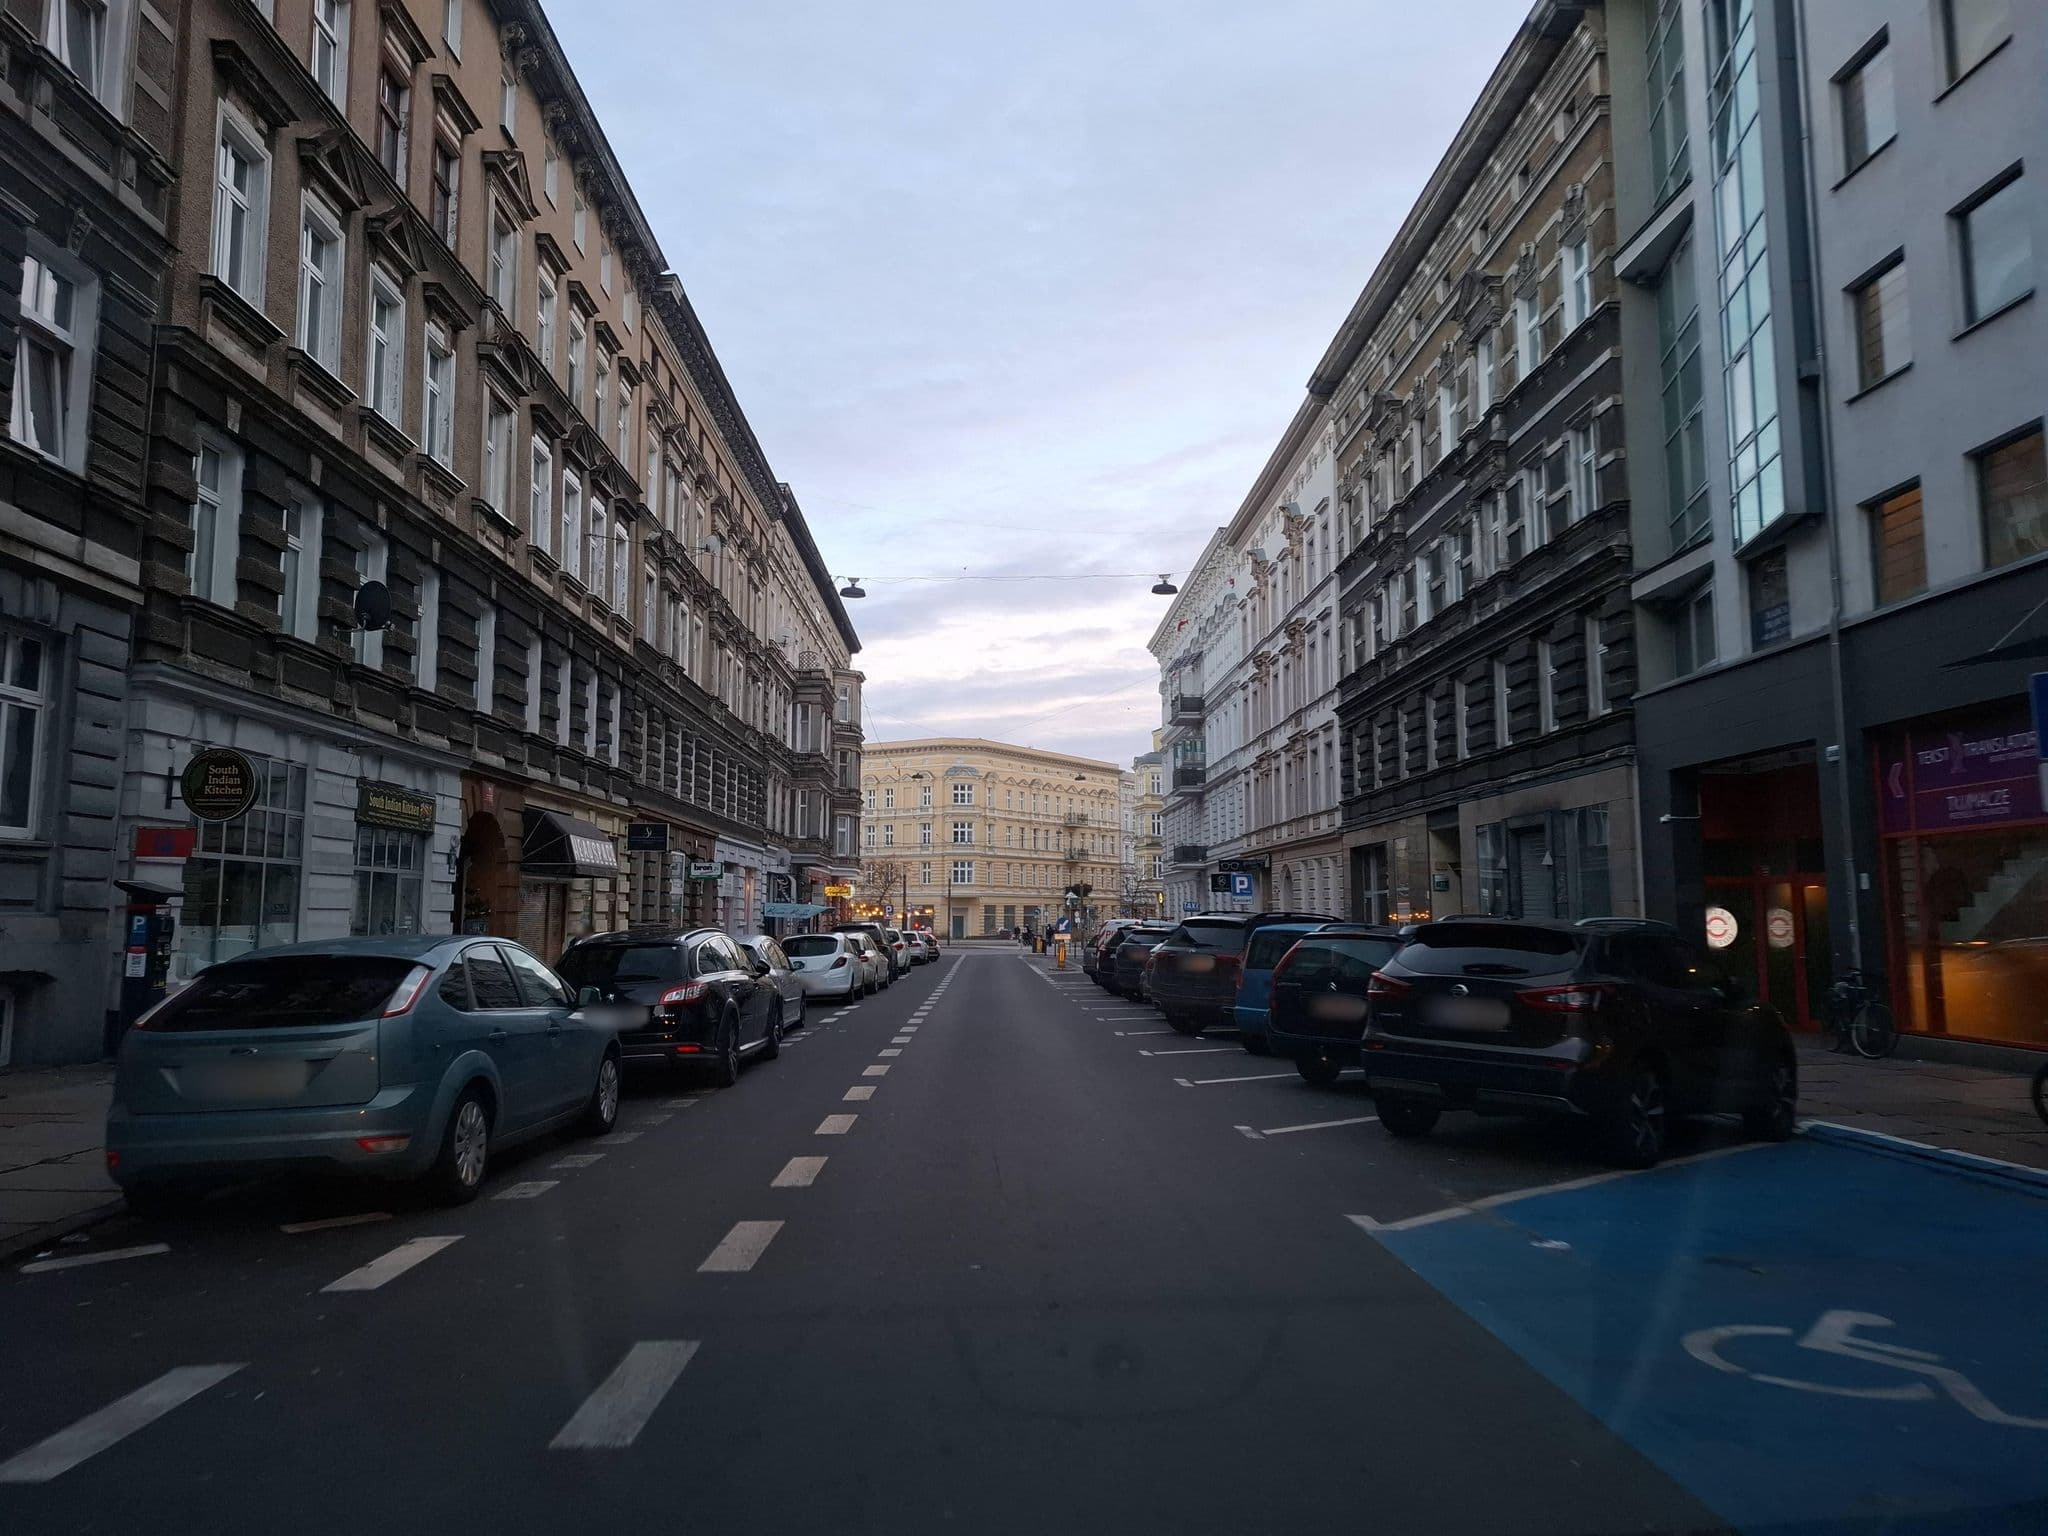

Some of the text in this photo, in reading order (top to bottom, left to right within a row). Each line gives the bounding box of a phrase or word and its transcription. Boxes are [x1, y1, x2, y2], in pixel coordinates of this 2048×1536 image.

[207, 764, 239, 775] South
[207, 775, 241, 785] Indian
[203, 784, 243, 795] Kitchen
[1235, 876, 1249, 894] P
[885, 906, 893, 914] P
[133, 915, 145, 931] P
